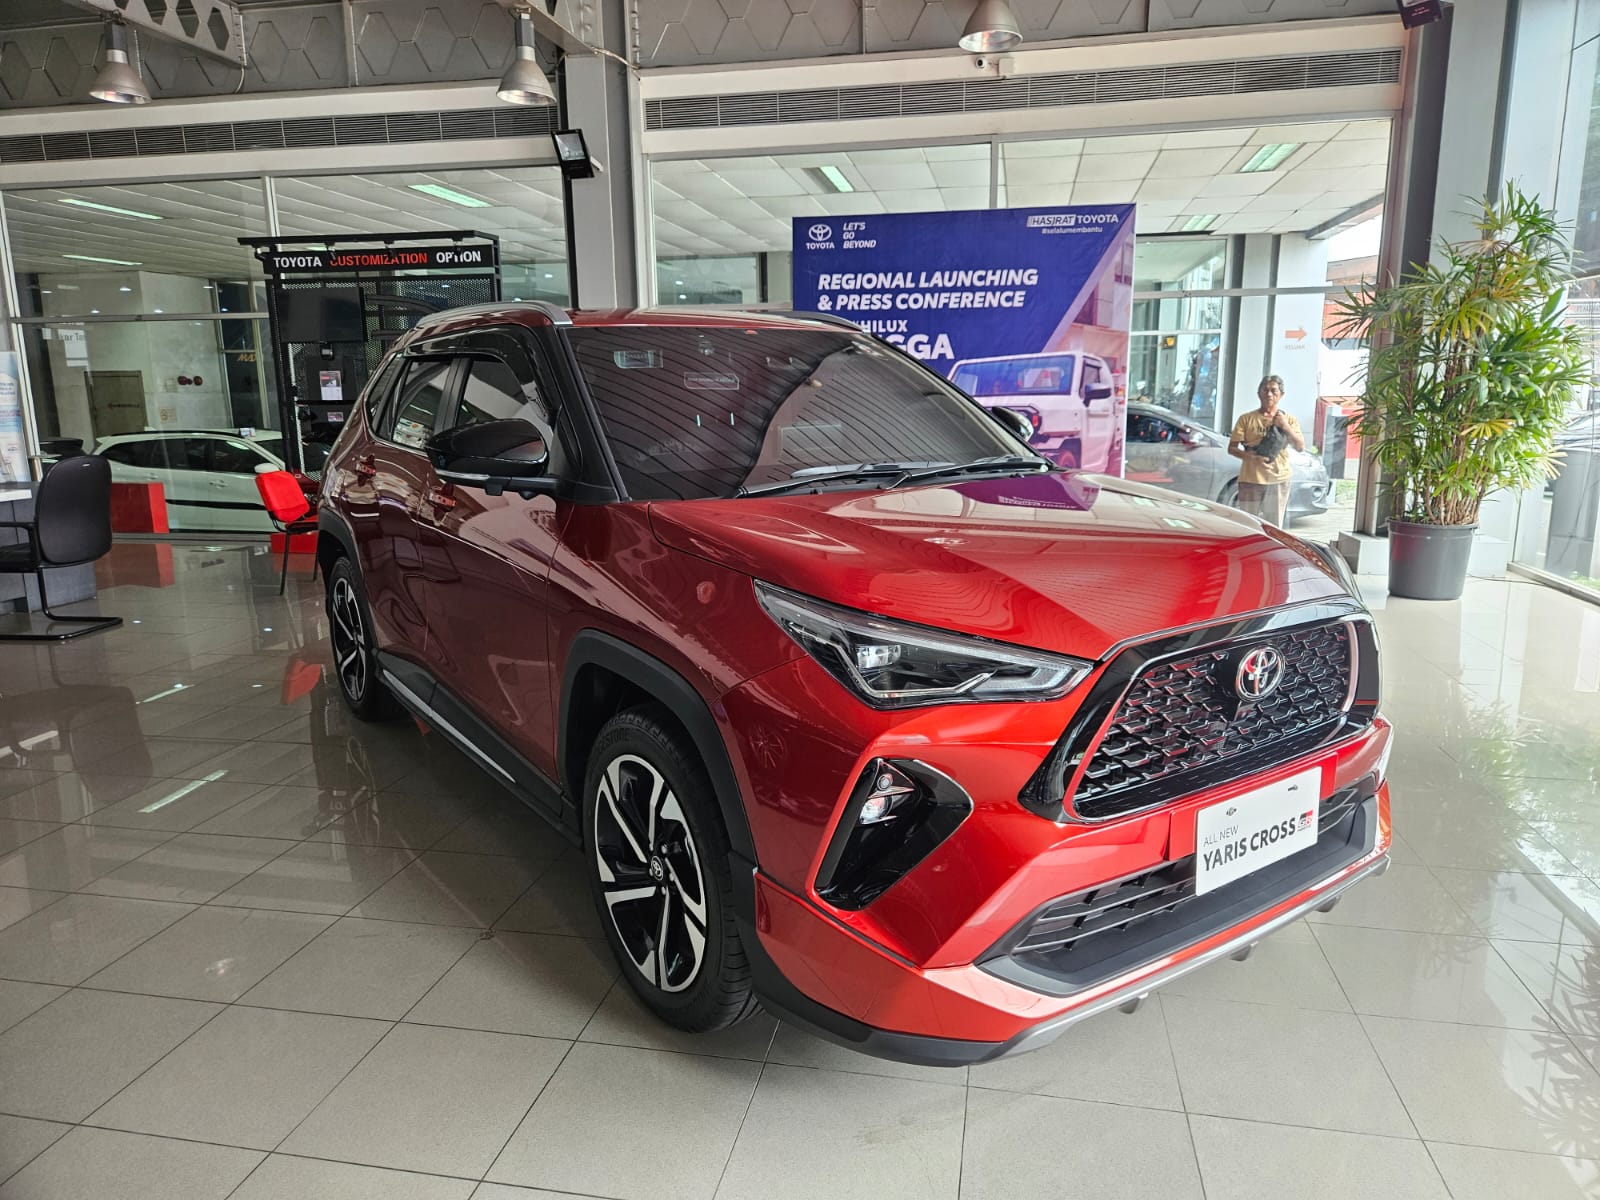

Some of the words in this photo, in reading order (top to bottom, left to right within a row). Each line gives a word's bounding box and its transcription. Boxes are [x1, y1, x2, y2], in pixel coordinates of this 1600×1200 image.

[1077, 213, 1119, 224] TOYOTA
[843, 231, 855, 240] GO
[1041, 226, 1103, 235] #selalumembantu
[805, 242, 835, 250] TOYOTA
[843, 239, 877, 249] BEYOND
[273, 256, 323, 268] TOYOTA
[436, 250, 482, 263] OPTION
[818, 271, 916, 290] REGIONAL
[919, 268, 1039, 289] LAUNCHING
[817, 294, 833, 311] &
[835, 293, 893, 310] PRESS
[895, 290, 1026, 310] CONFERENCE
[860, 319, 908, 333] HILUX
[1203, 836, 1217, 848] ALL
[1219, 825, 1239, 841] NEW
[1203, 837, 1247, 872] YARIS
[1250, 817, 1296, 851] CROSS
